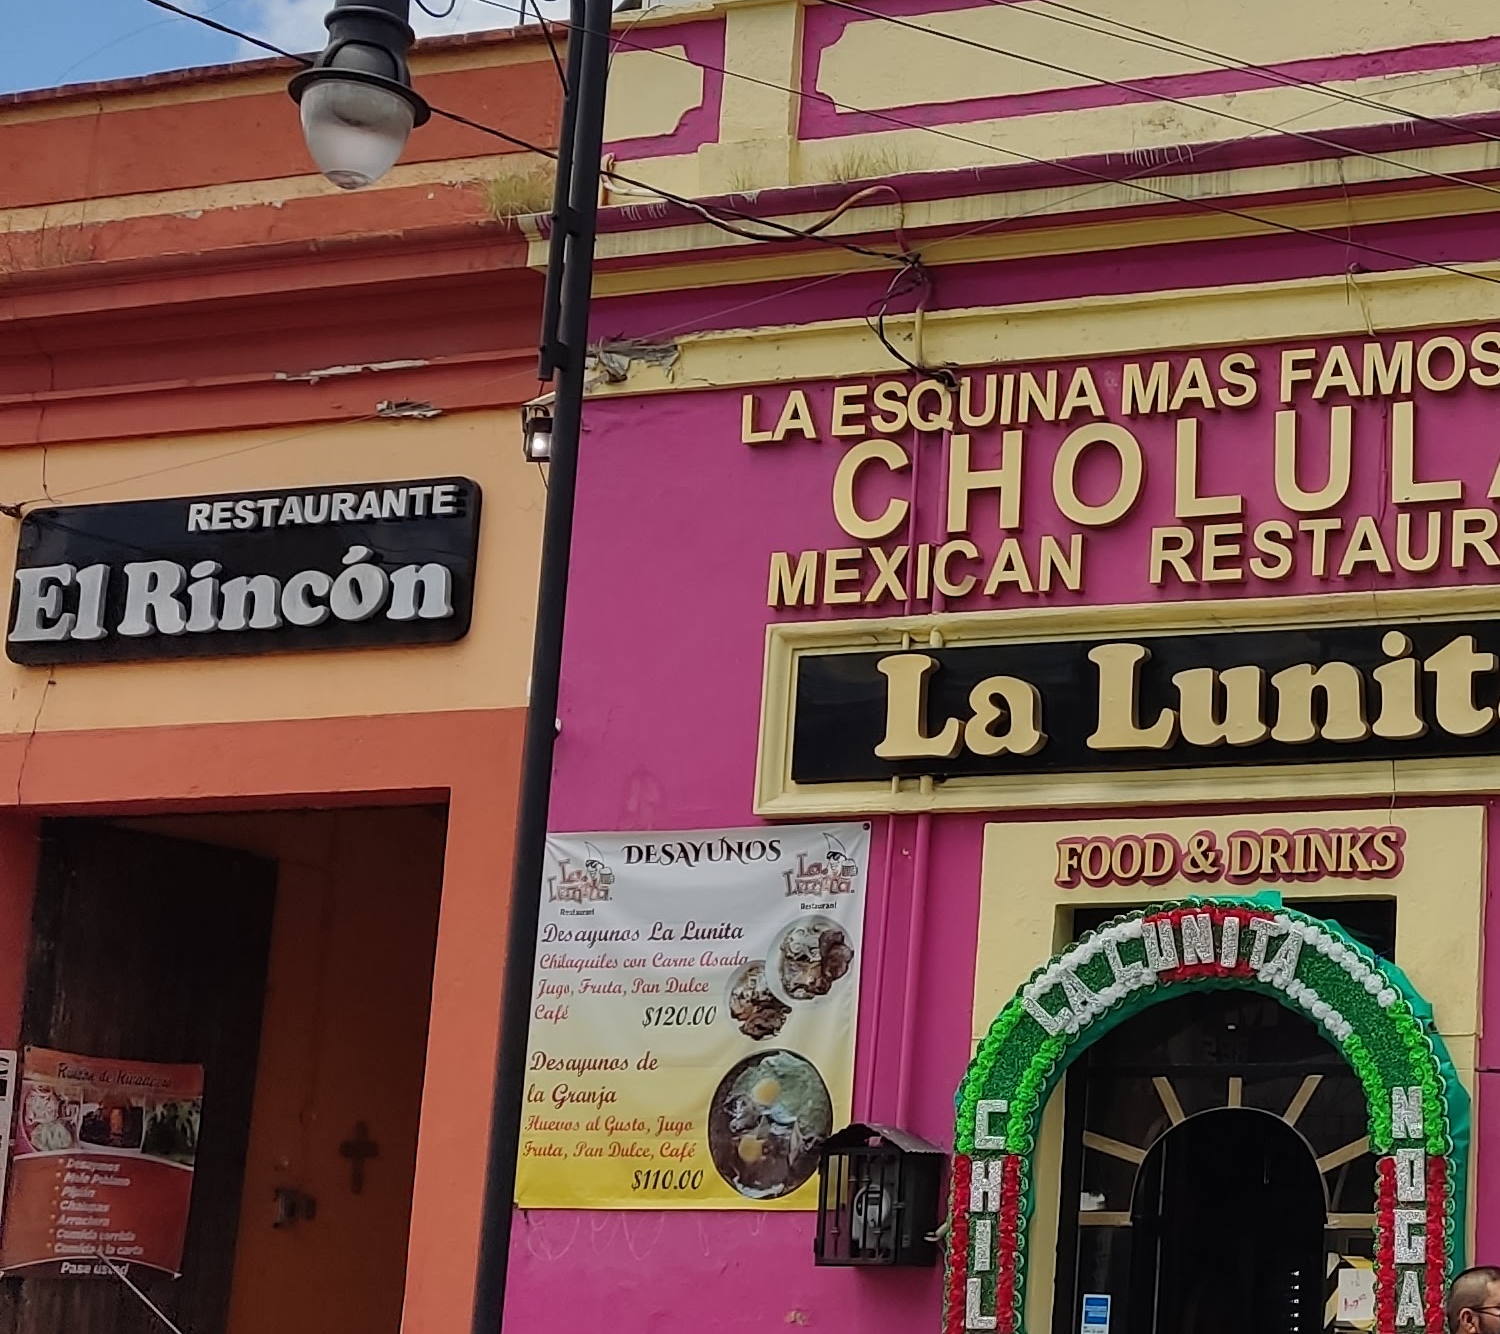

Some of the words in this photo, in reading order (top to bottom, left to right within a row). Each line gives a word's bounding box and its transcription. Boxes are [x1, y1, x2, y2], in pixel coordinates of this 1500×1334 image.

[741, 391, 816, 447] LA
[831, 368, 1106, 437] ESQUINA
[1121, 351, 1260, 421] MAS
[187, 484, 460, 532] RESTAURANTE
[767, 532, 1084, 608] MEXICAN
[8, 563, 111, 643] El
[116, 545, 456, 638] Rincón
[874, 651, 1049, 762] La
[621, 835, 783, 869] DESAYUNOS
[1056, 835, 1178, 884] FOOD
[1186, 831, 1221, 874] &
[1227, 829, 1399, 877] DRINKS
[541, 923, 640, 949] Desayunos
[647, 921, 675, 941] La
[680, 920, 745, 941] Lunita
[539, 953, 618, 973] Chilaquiles
[623, 958, 646, 968] con
[652, 952, 695, 967] Carne
[700, 951, 749, 967] Asada
[1022, 969, 1101, 1037] LA
[1102, 912, 1304, 985] LUNITA
[536, 978, 574, 999] Jugo,
[578, 978, 627, 996] Fruta,
[631, 977, 660, 994] Pan
[664, 976, 710, 993] Dulce
[534, 1004, 569, 1025] Café
[641, 1005, 717, 1027] $120.00
[529, 1050, 629, 1077] Desayunos
[636, 1050, 659, 1071] de
[527, 1083, 545, 1103] la
[551, 1082, 617, 1110] Granja
[524, 1115, 581, 1132] Huevos
[585, 1115, 601, 1132] al
[604, 1115, 651, 1137] Gusto,
[655, 1115, 695, 1137] Jugo
[522, 1140, 568, 1160] Fruta,
[573, 1141, 604, 1158] Pan
[608, 1141, 655, 1160] Dulce,
[659, 1141, 697, 1163] Café
[631, 1169, 704, 1192] $110.00
[60, 1261, 91, 1274] Pase
